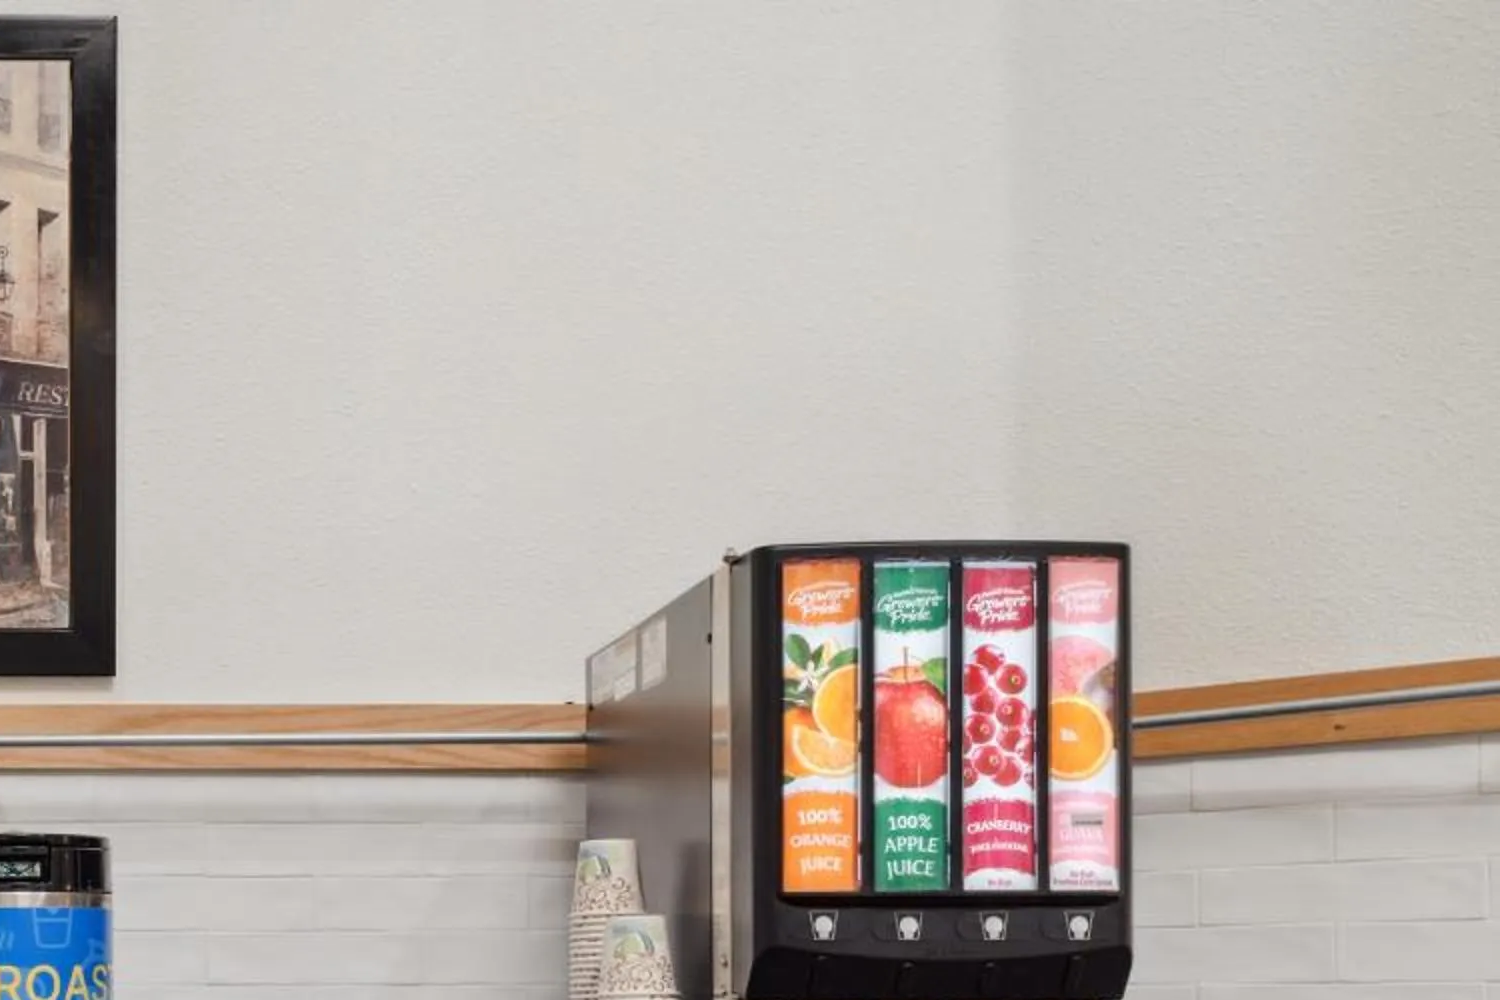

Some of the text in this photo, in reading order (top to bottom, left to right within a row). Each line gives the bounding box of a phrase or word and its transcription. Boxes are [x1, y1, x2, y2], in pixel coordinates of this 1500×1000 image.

[888, 813, 933, 831] 100%
[884, 836, 939, 853] APPLE
[800, 856, 843, 875] JUICE
[886, 859, 937, 881] JUICE
